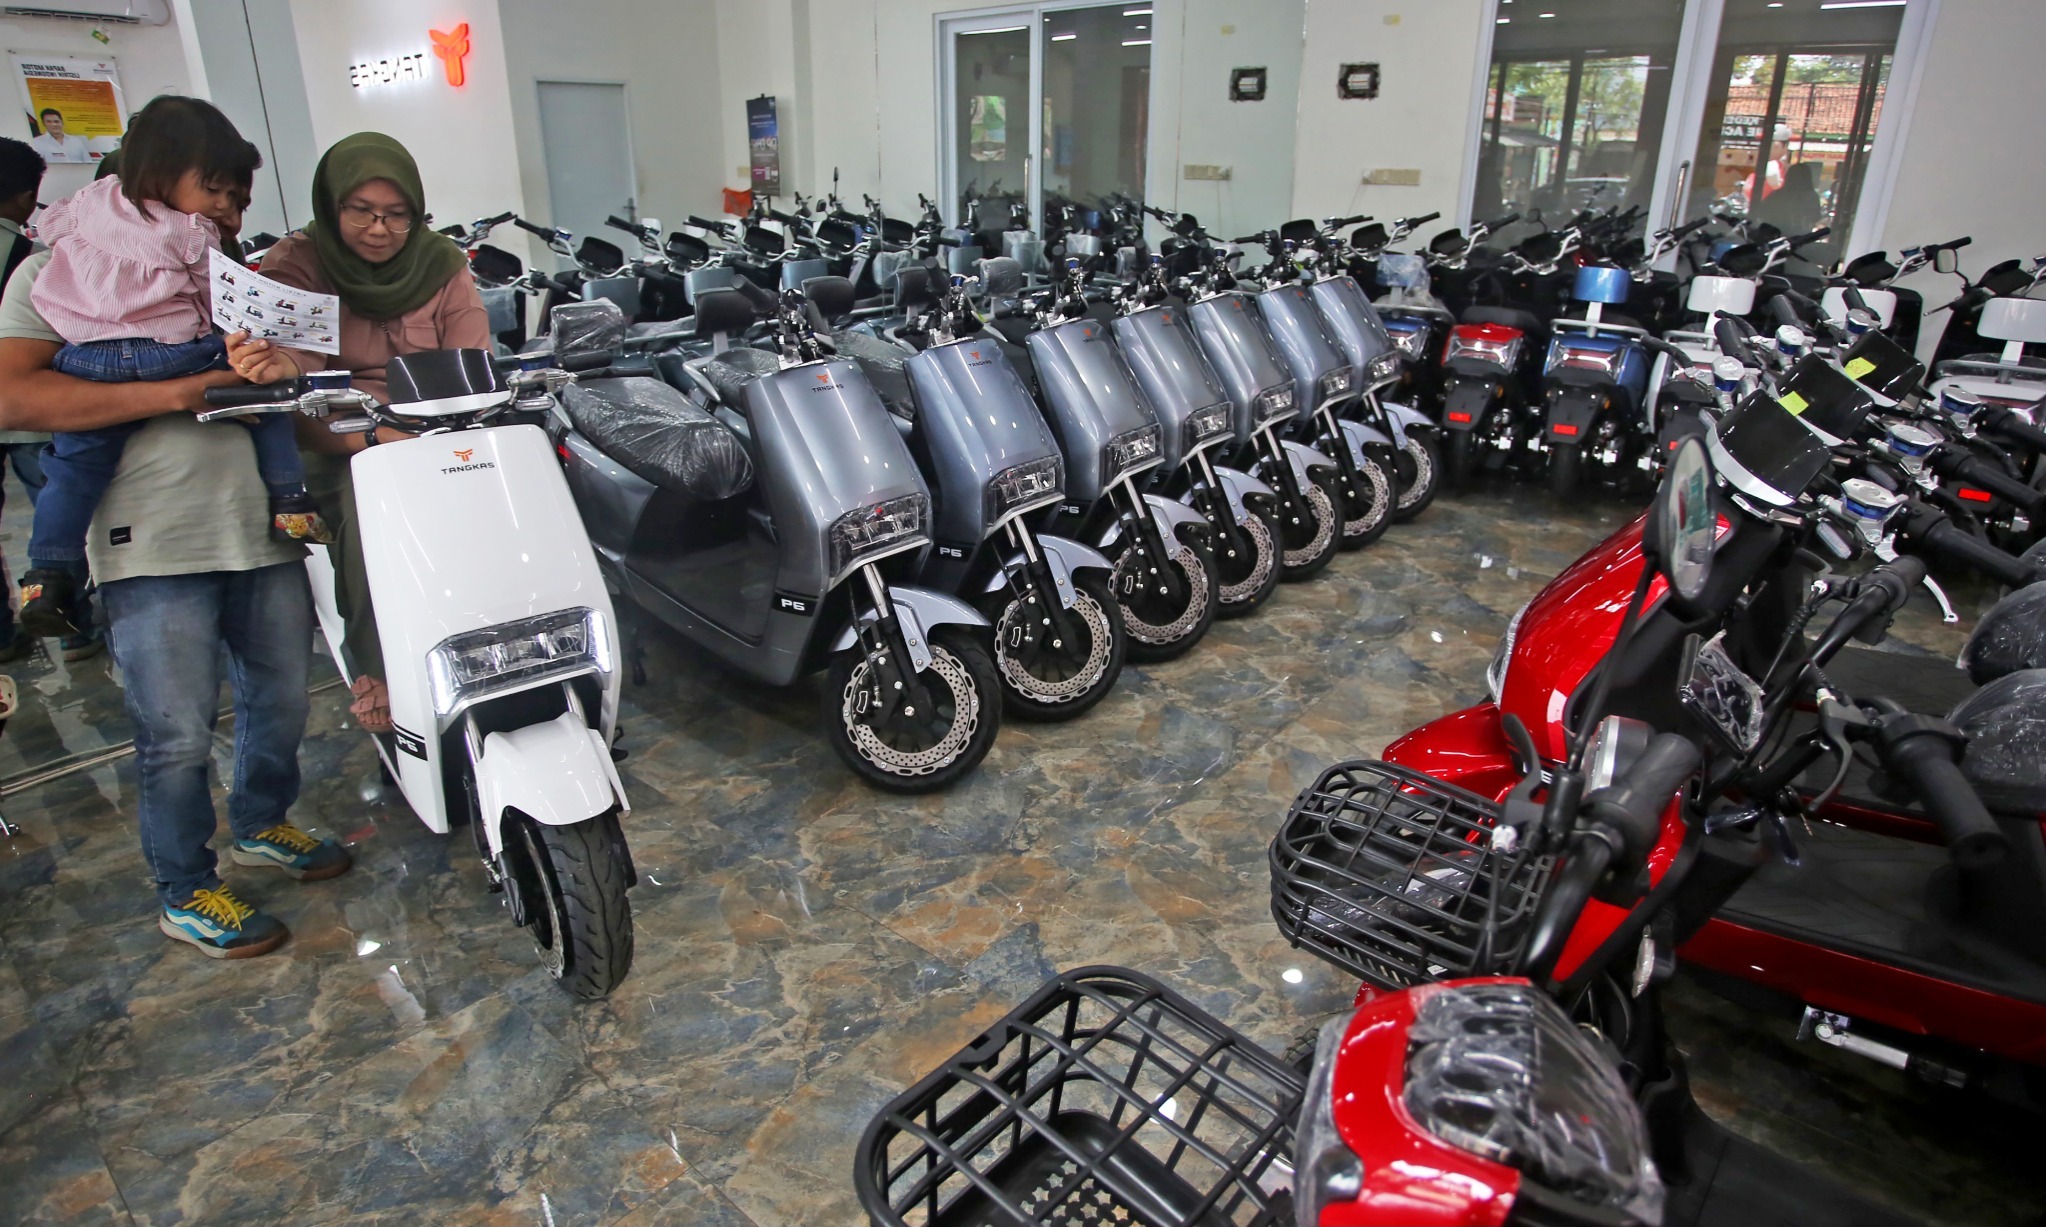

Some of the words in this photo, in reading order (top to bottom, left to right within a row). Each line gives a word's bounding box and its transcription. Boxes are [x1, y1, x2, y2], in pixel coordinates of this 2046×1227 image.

[440, 462, 495, 475] TANGKAS
[1059, 504, 1080, 514] P6
[939, 546, 963, 558] P6
[780, 598, 806, 611] P6
[396, 734, 419, 752] P6
